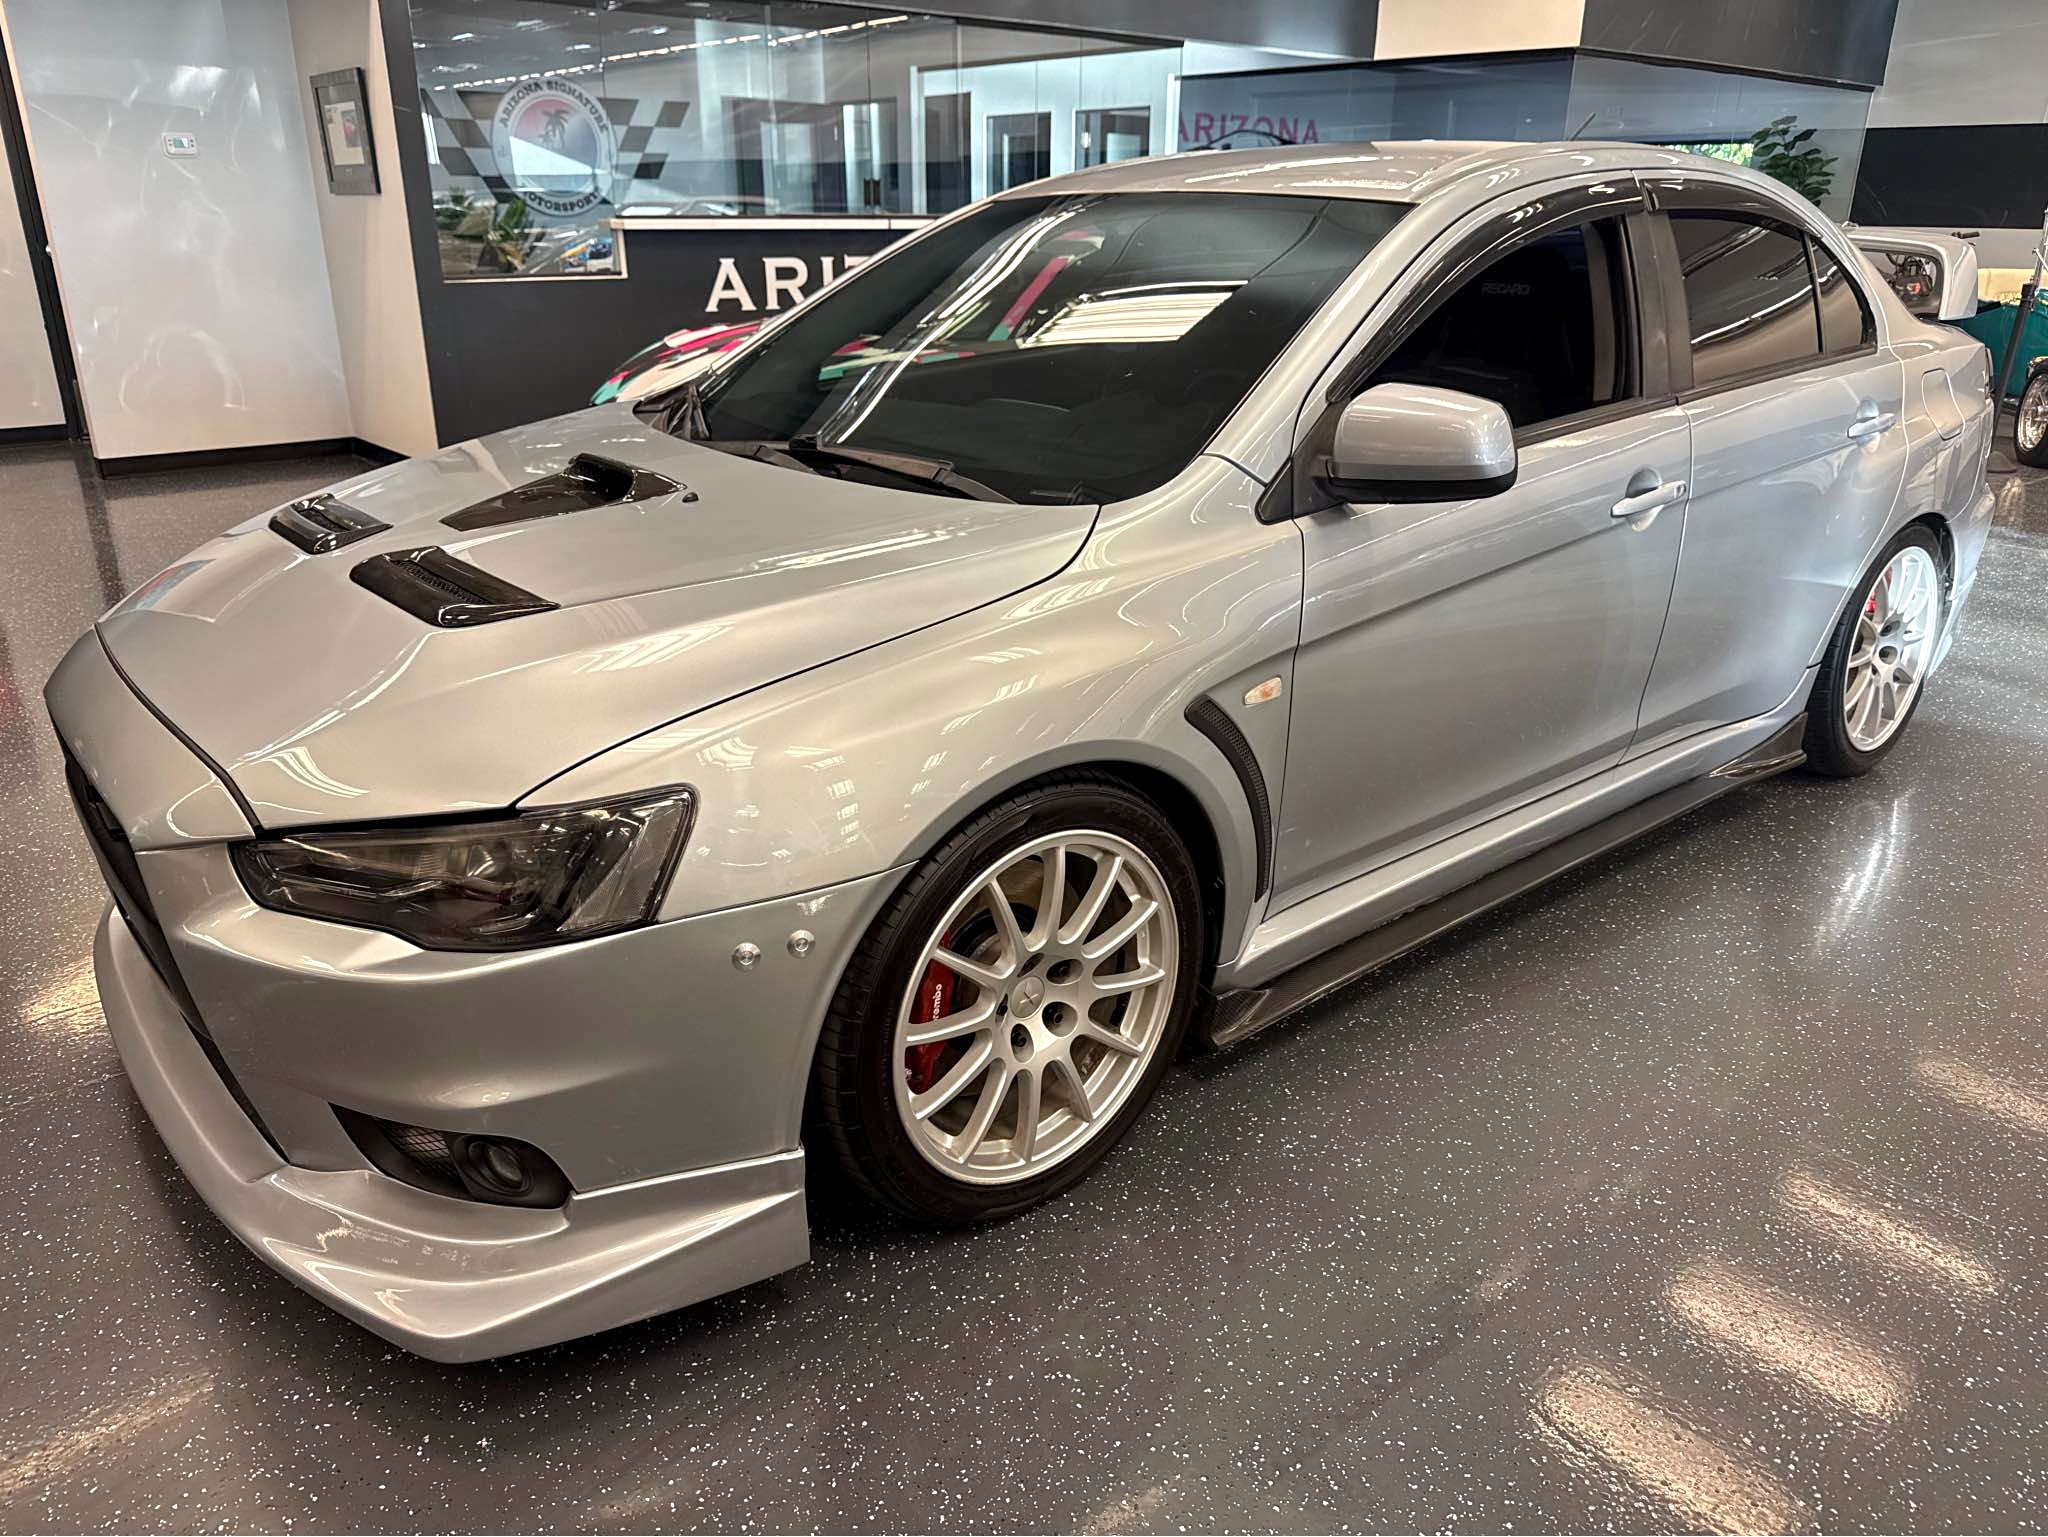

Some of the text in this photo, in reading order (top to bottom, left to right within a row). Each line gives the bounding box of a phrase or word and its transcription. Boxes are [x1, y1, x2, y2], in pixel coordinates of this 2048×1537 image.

[500, 80, 609, 134] ARIZONA SIGNATURE
[705, 254, 871, 313] ARI
[932, 983, 943, 1020] rembo
